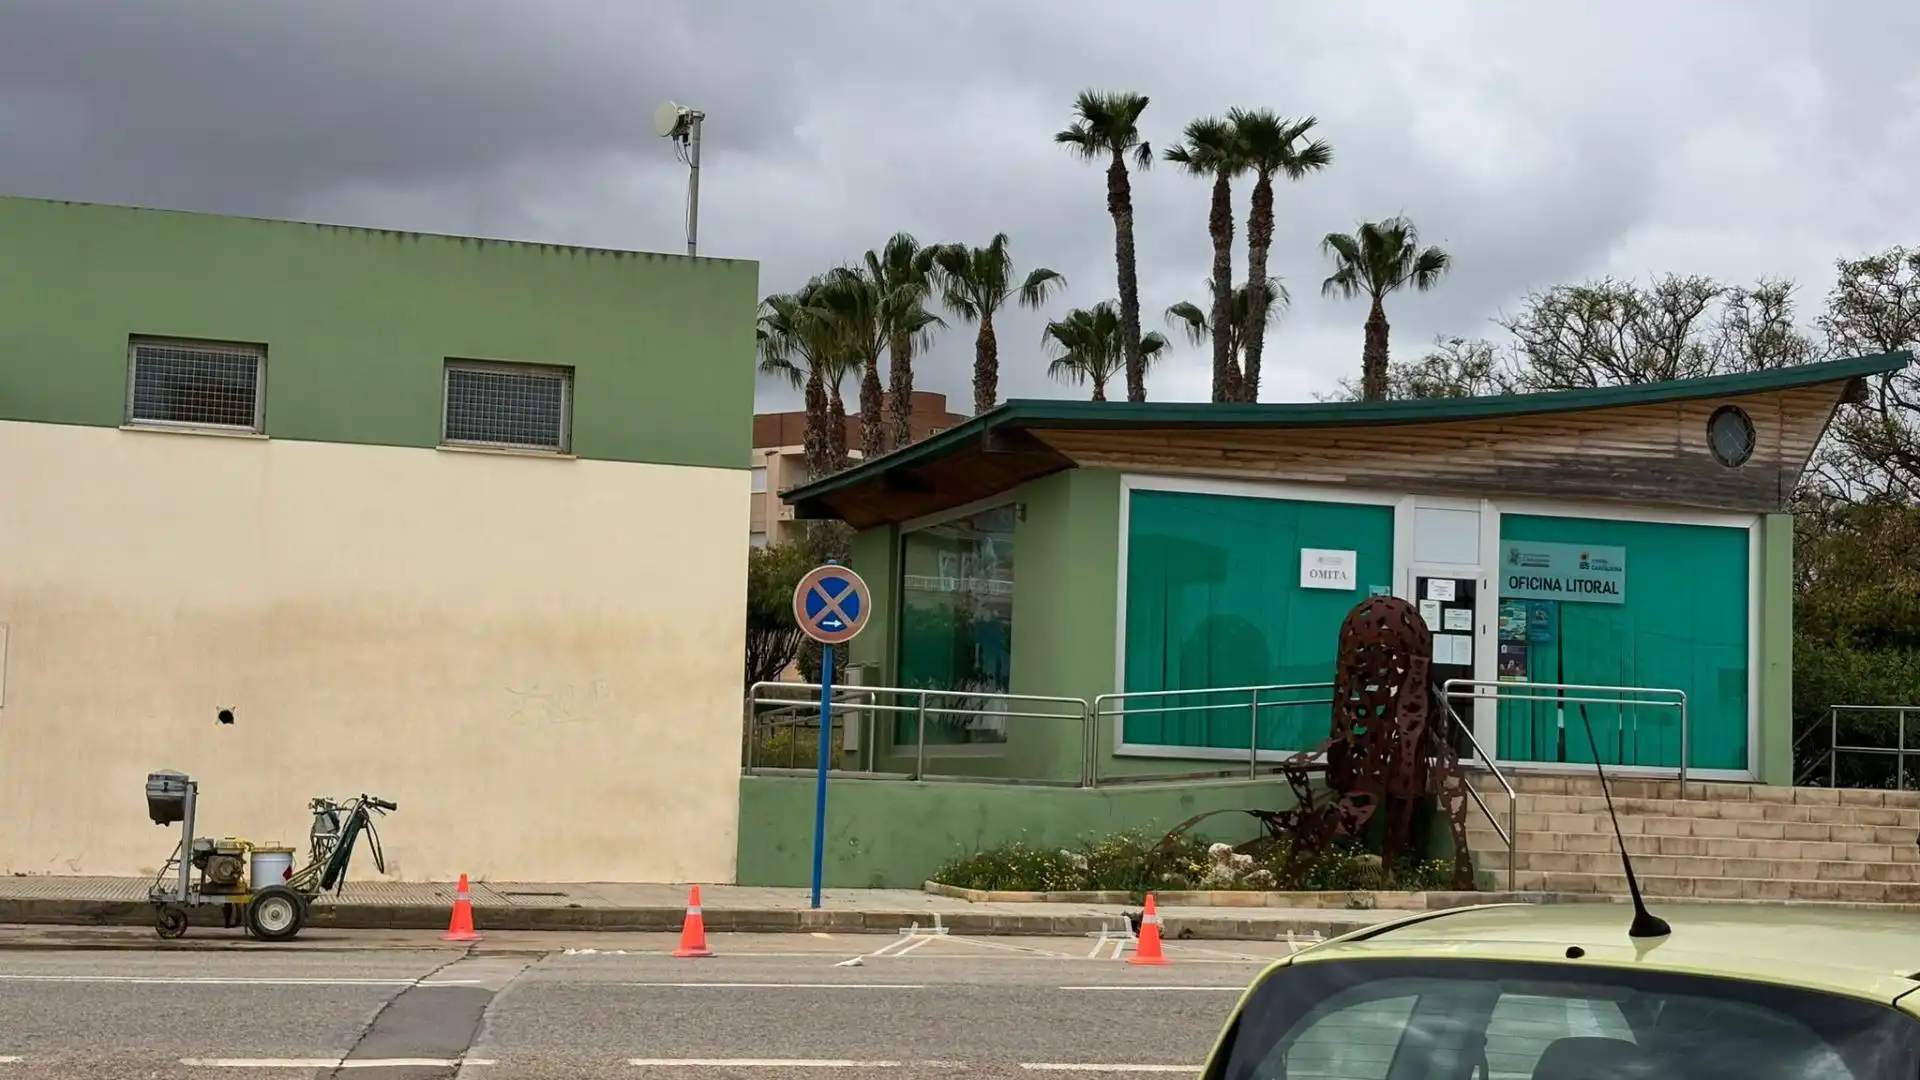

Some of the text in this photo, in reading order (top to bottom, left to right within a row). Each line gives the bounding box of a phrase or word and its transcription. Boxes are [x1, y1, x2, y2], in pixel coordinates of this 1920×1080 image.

[1309, 569, 1347, 580] OMITA
[1509, 576, 1619, 595] OFICINA LITORAL
